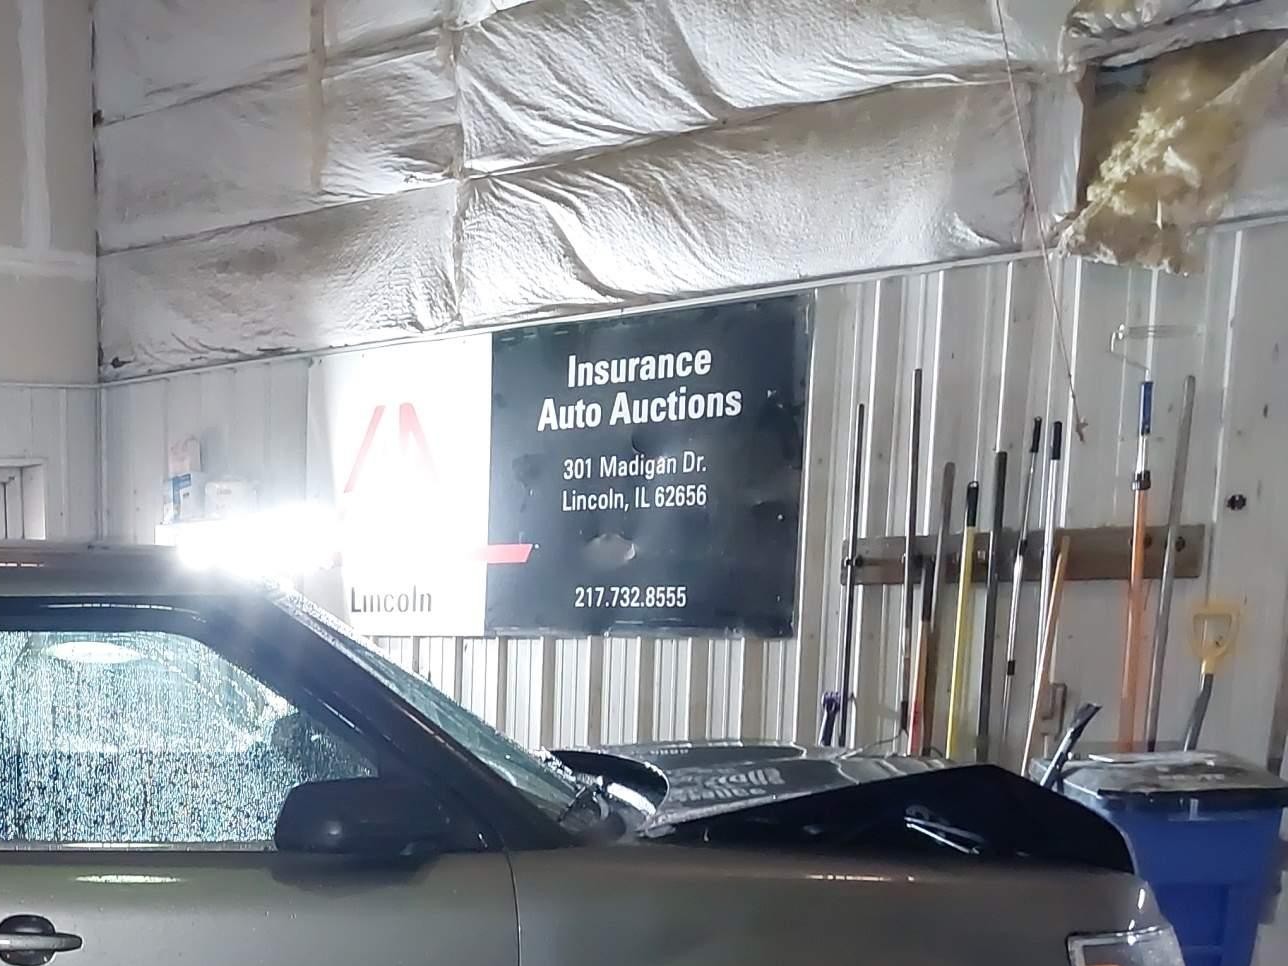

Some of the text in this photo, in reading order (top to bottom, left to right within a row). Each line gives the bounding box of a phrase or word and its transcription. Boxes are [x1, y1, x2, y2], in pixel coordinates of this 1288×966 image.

[567, 349, 712, 388] Insurance
[537, 386, 742, 433] Auto Auctions
[563, 450, 707, 480] 301 Madigan Dr.
[562, 484, 707, 512] Lincoln, IL 62656
[350, 584, 432, 614] Lincoln
[574, 586, 687, 608] 217.732.8555
